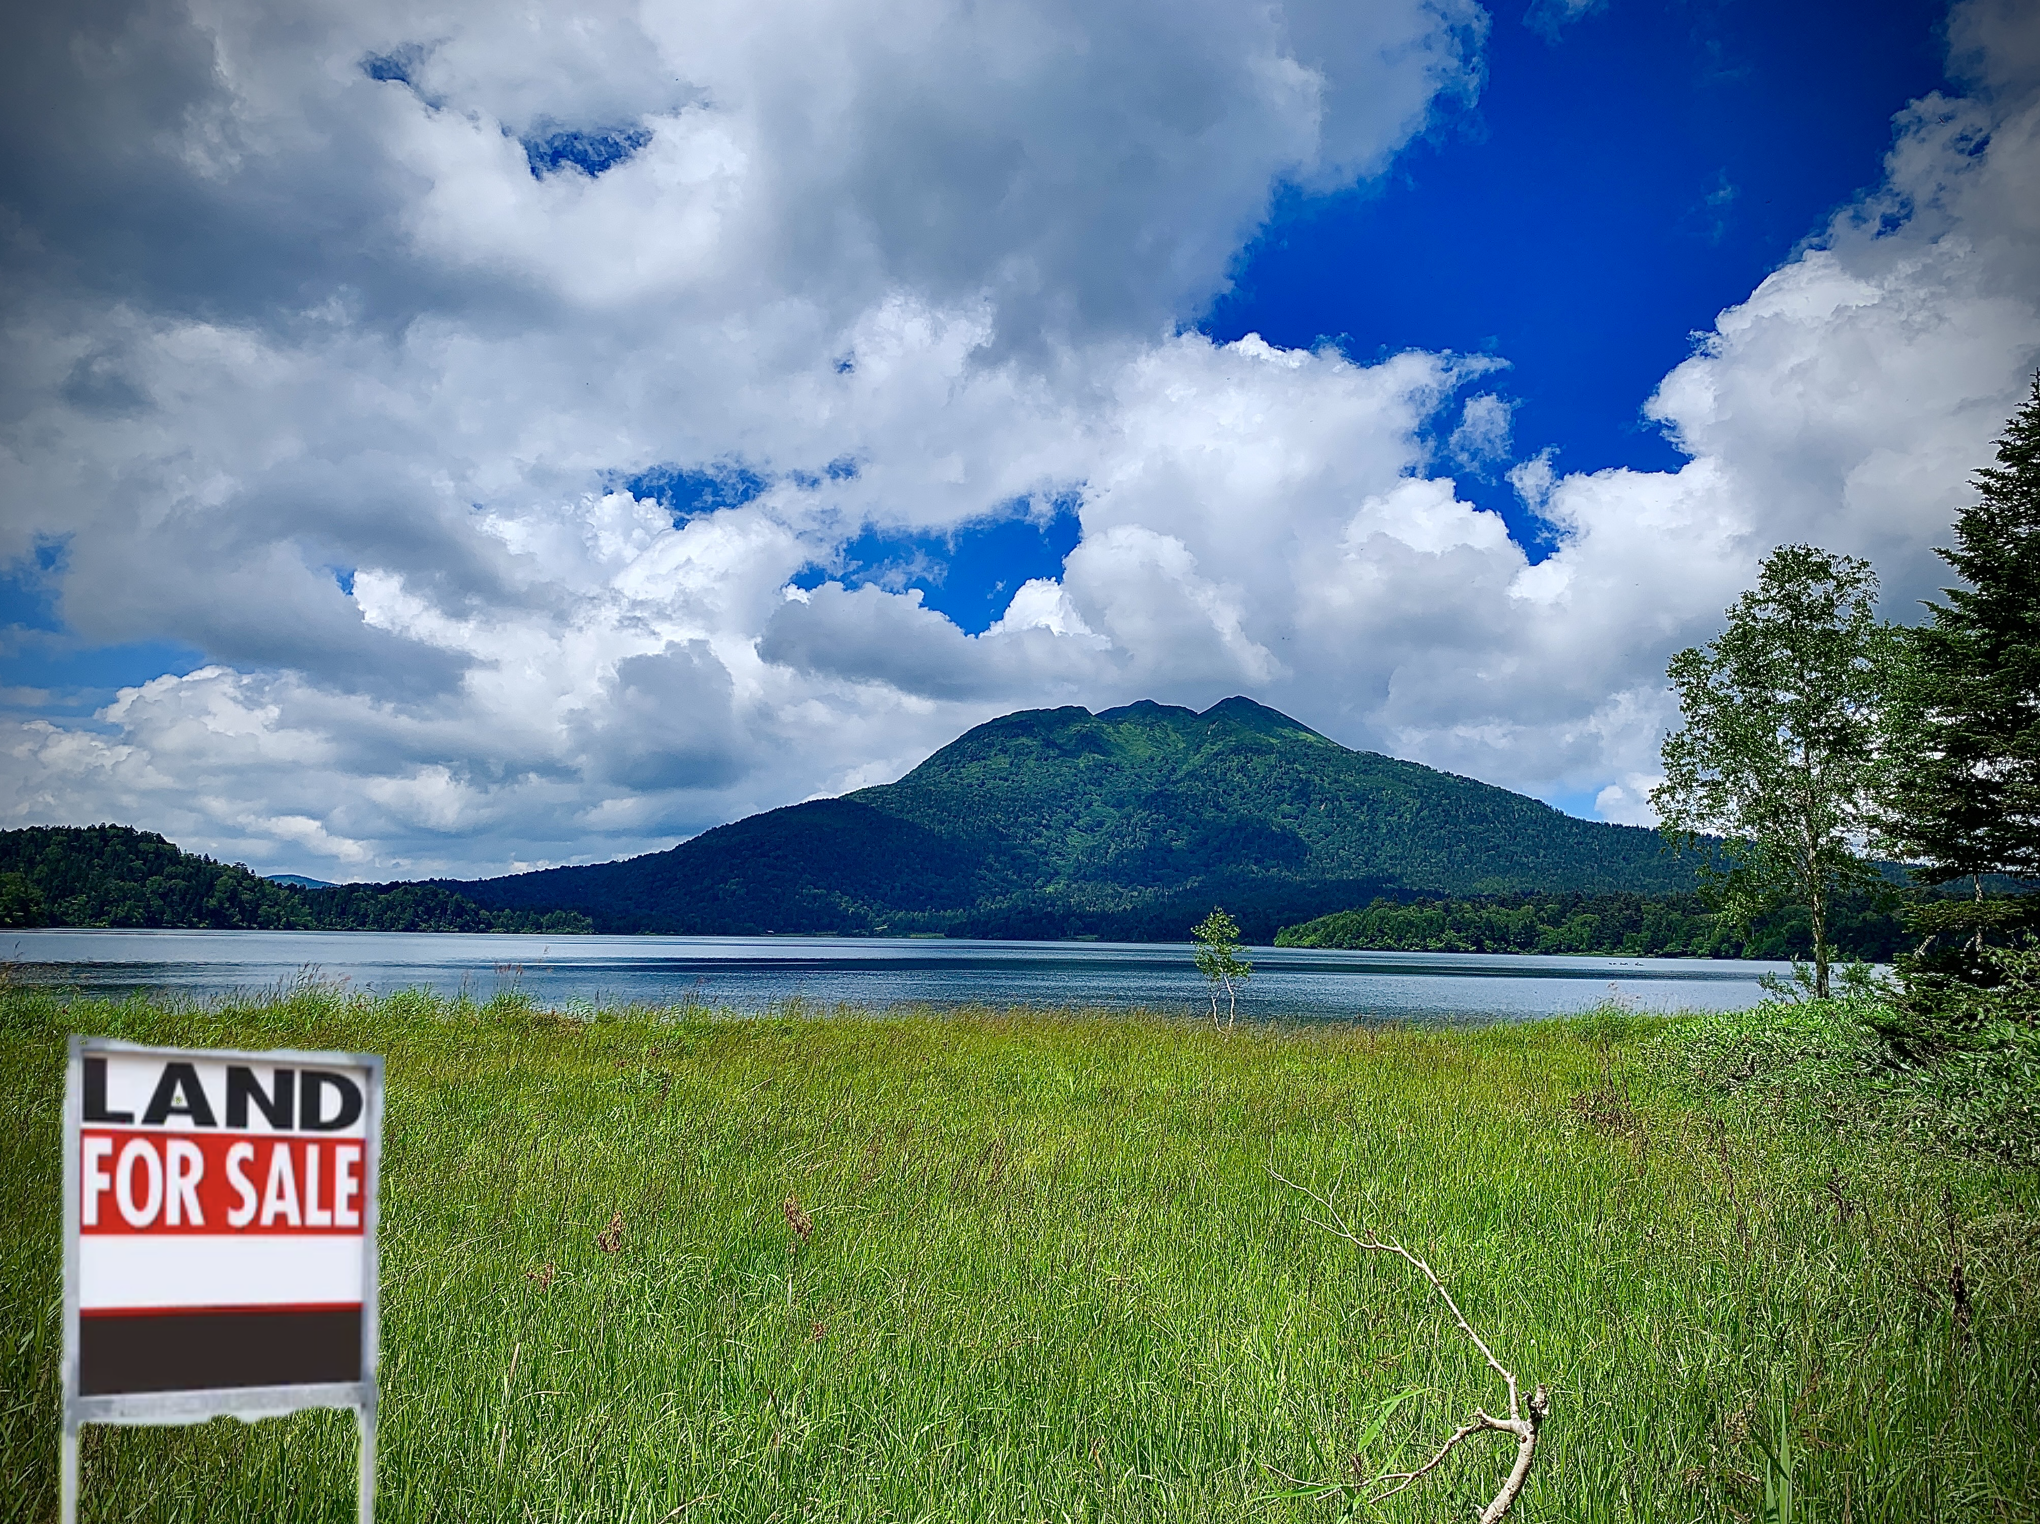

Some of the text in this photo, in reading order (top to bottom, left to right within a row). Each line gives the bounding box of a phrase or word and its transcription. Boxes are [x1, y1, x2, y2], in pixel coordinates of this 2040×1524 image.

[82, 1057, 363, 1131] LAND
[82, 1135, 361, 1229] FOR SALE
